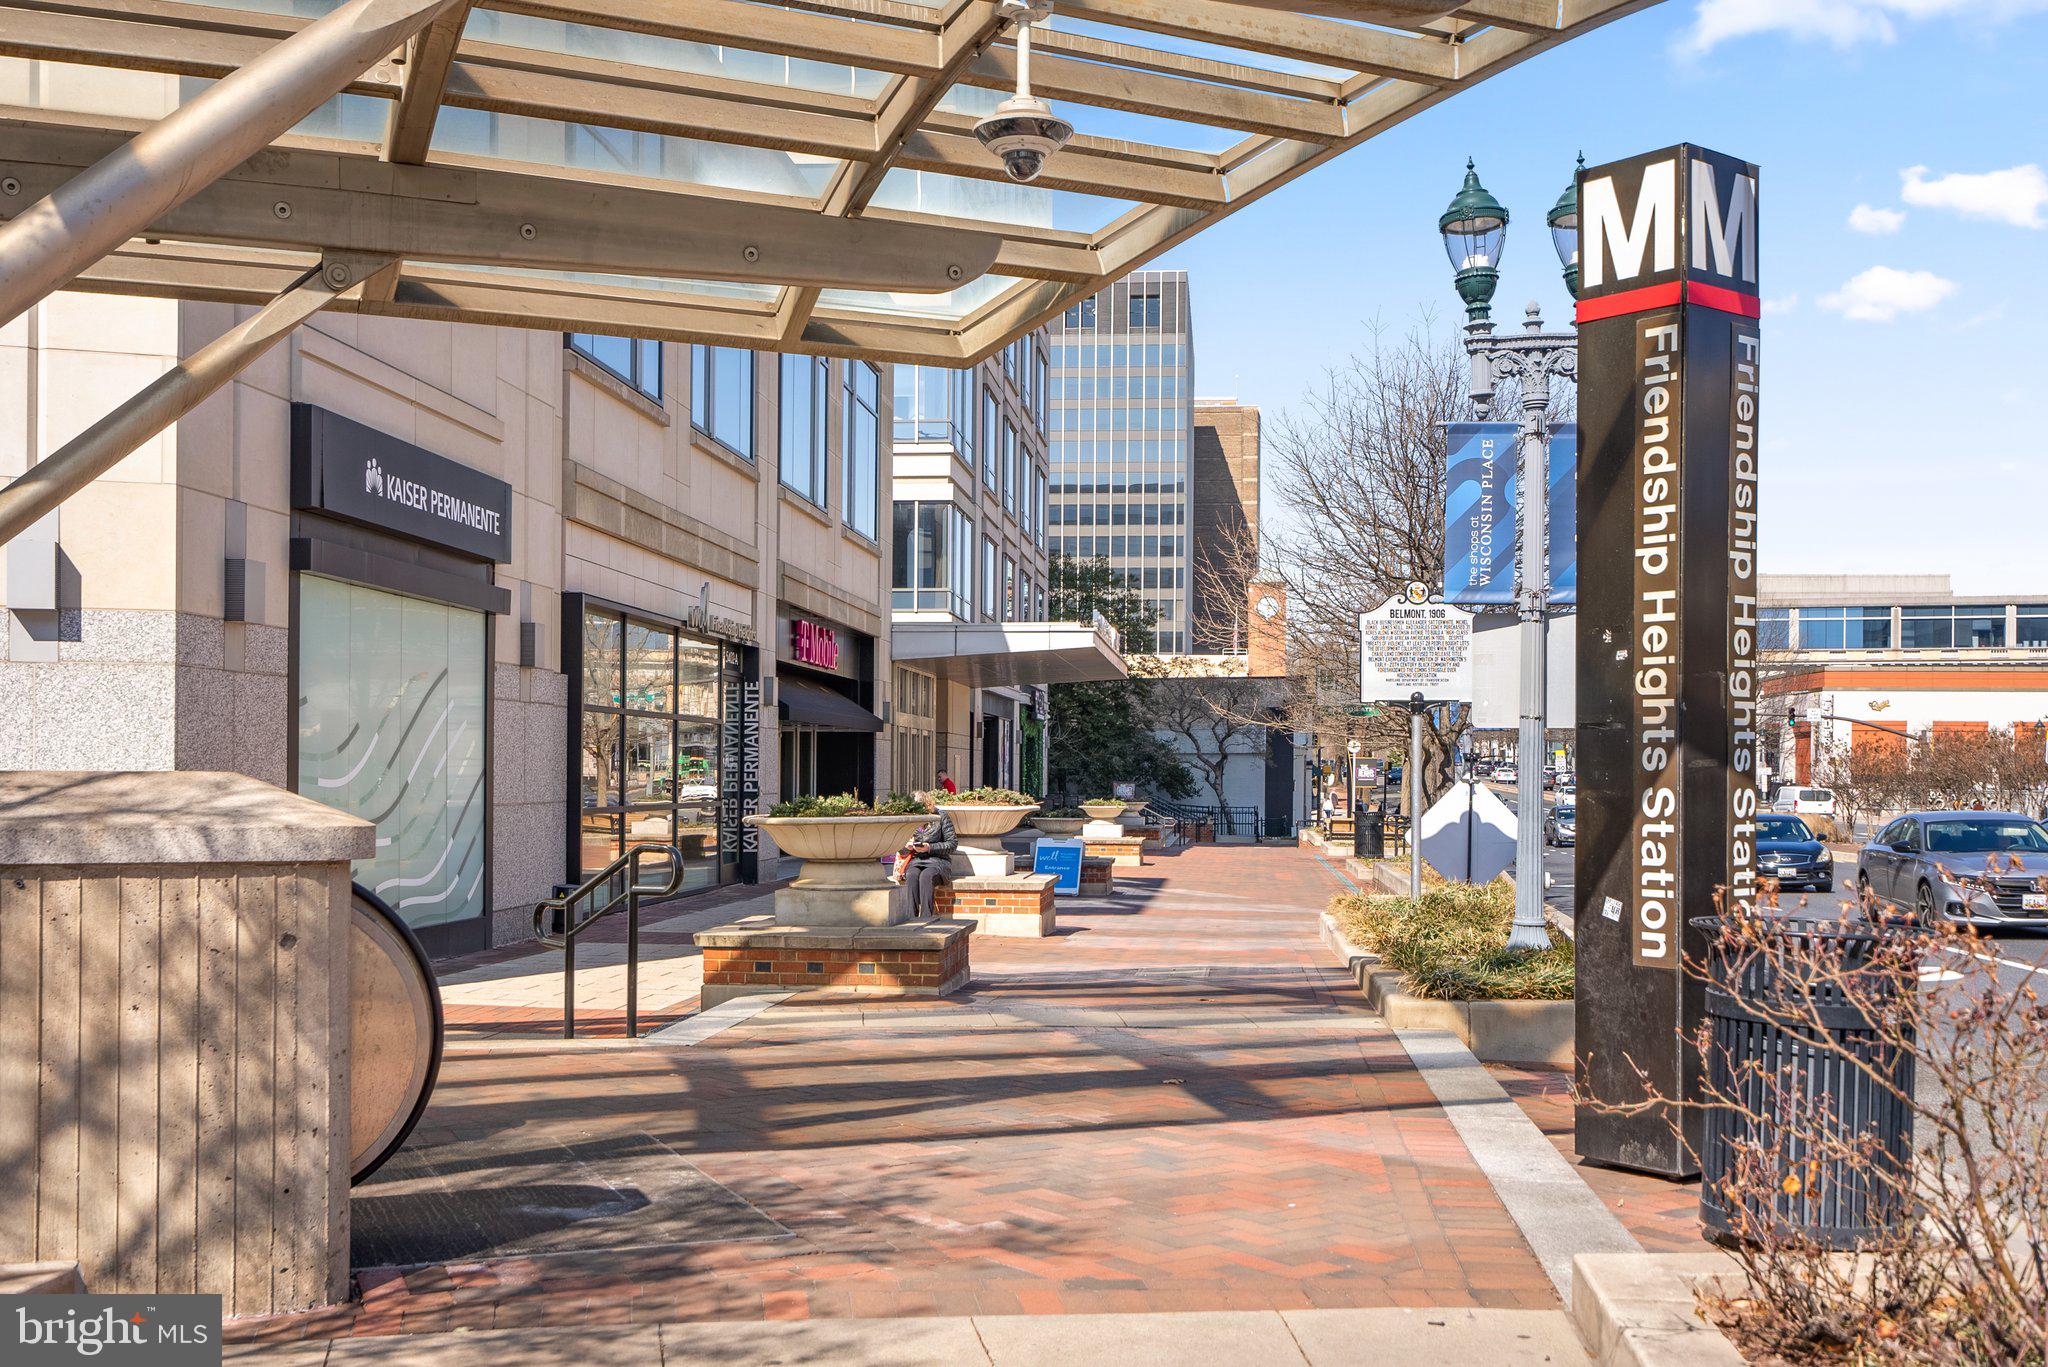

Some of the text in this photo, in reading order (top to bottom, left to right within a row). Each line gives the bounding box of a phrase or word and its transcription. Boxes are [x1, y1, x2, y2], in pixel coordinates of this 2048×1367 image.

[1583, 159, 1675, 288] M
[1691, 159, 1756, 284] M
[387, 474, 501, 536] KAISER PERMANENTE
[1480, 439, 1494, 587] WISCONSIN PLACE
[1729, 334, 1759, 580] Friendship
[1429, 609, 1446, 619] 1906
[1469, 516, 1481, 586] the shops at
[1635, 323, 1678, 958] Friendship Heights Station
[1729, 595, 1756, 773] Heights
[743, 681, 759, 792] PERMANENTE
